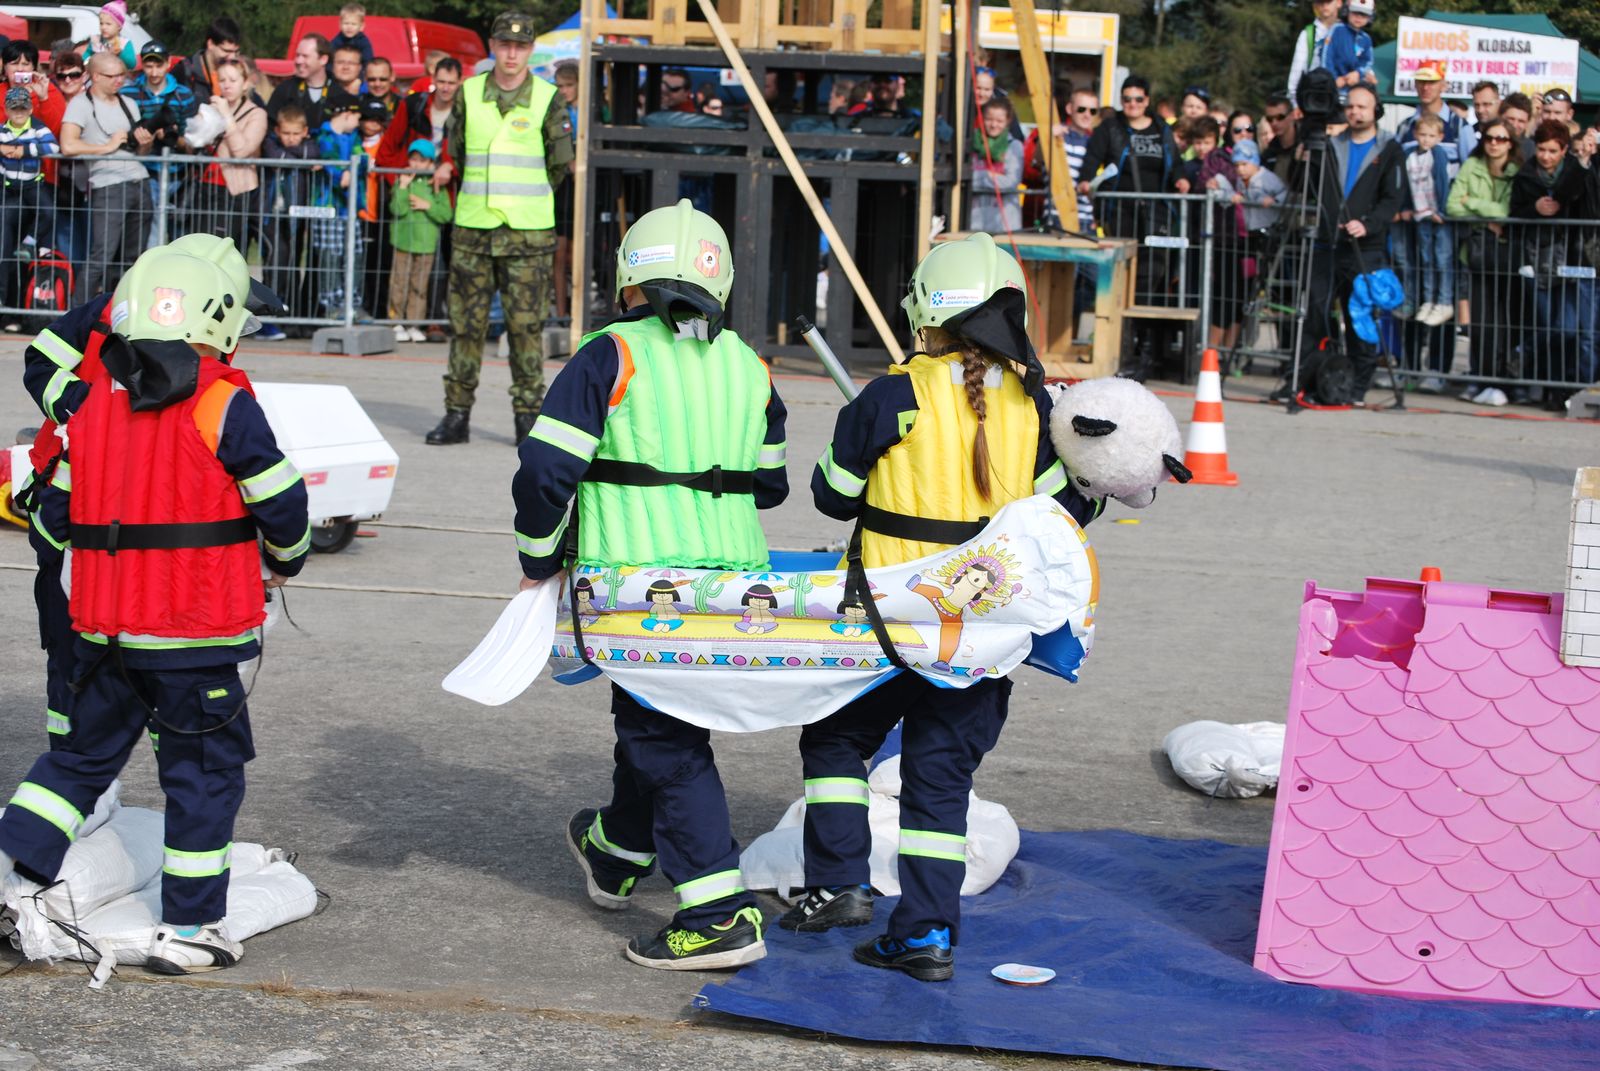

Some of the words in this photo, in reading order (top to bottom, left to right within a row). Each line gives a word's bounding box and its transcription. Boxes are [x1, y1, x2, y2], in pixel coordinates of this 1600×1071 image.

[1402, 29, 1470, 52] LANGOŠ
[1477, 37, 1532, 54] KLOBÁSA
[1525, 61, 1547, 75] HOT
